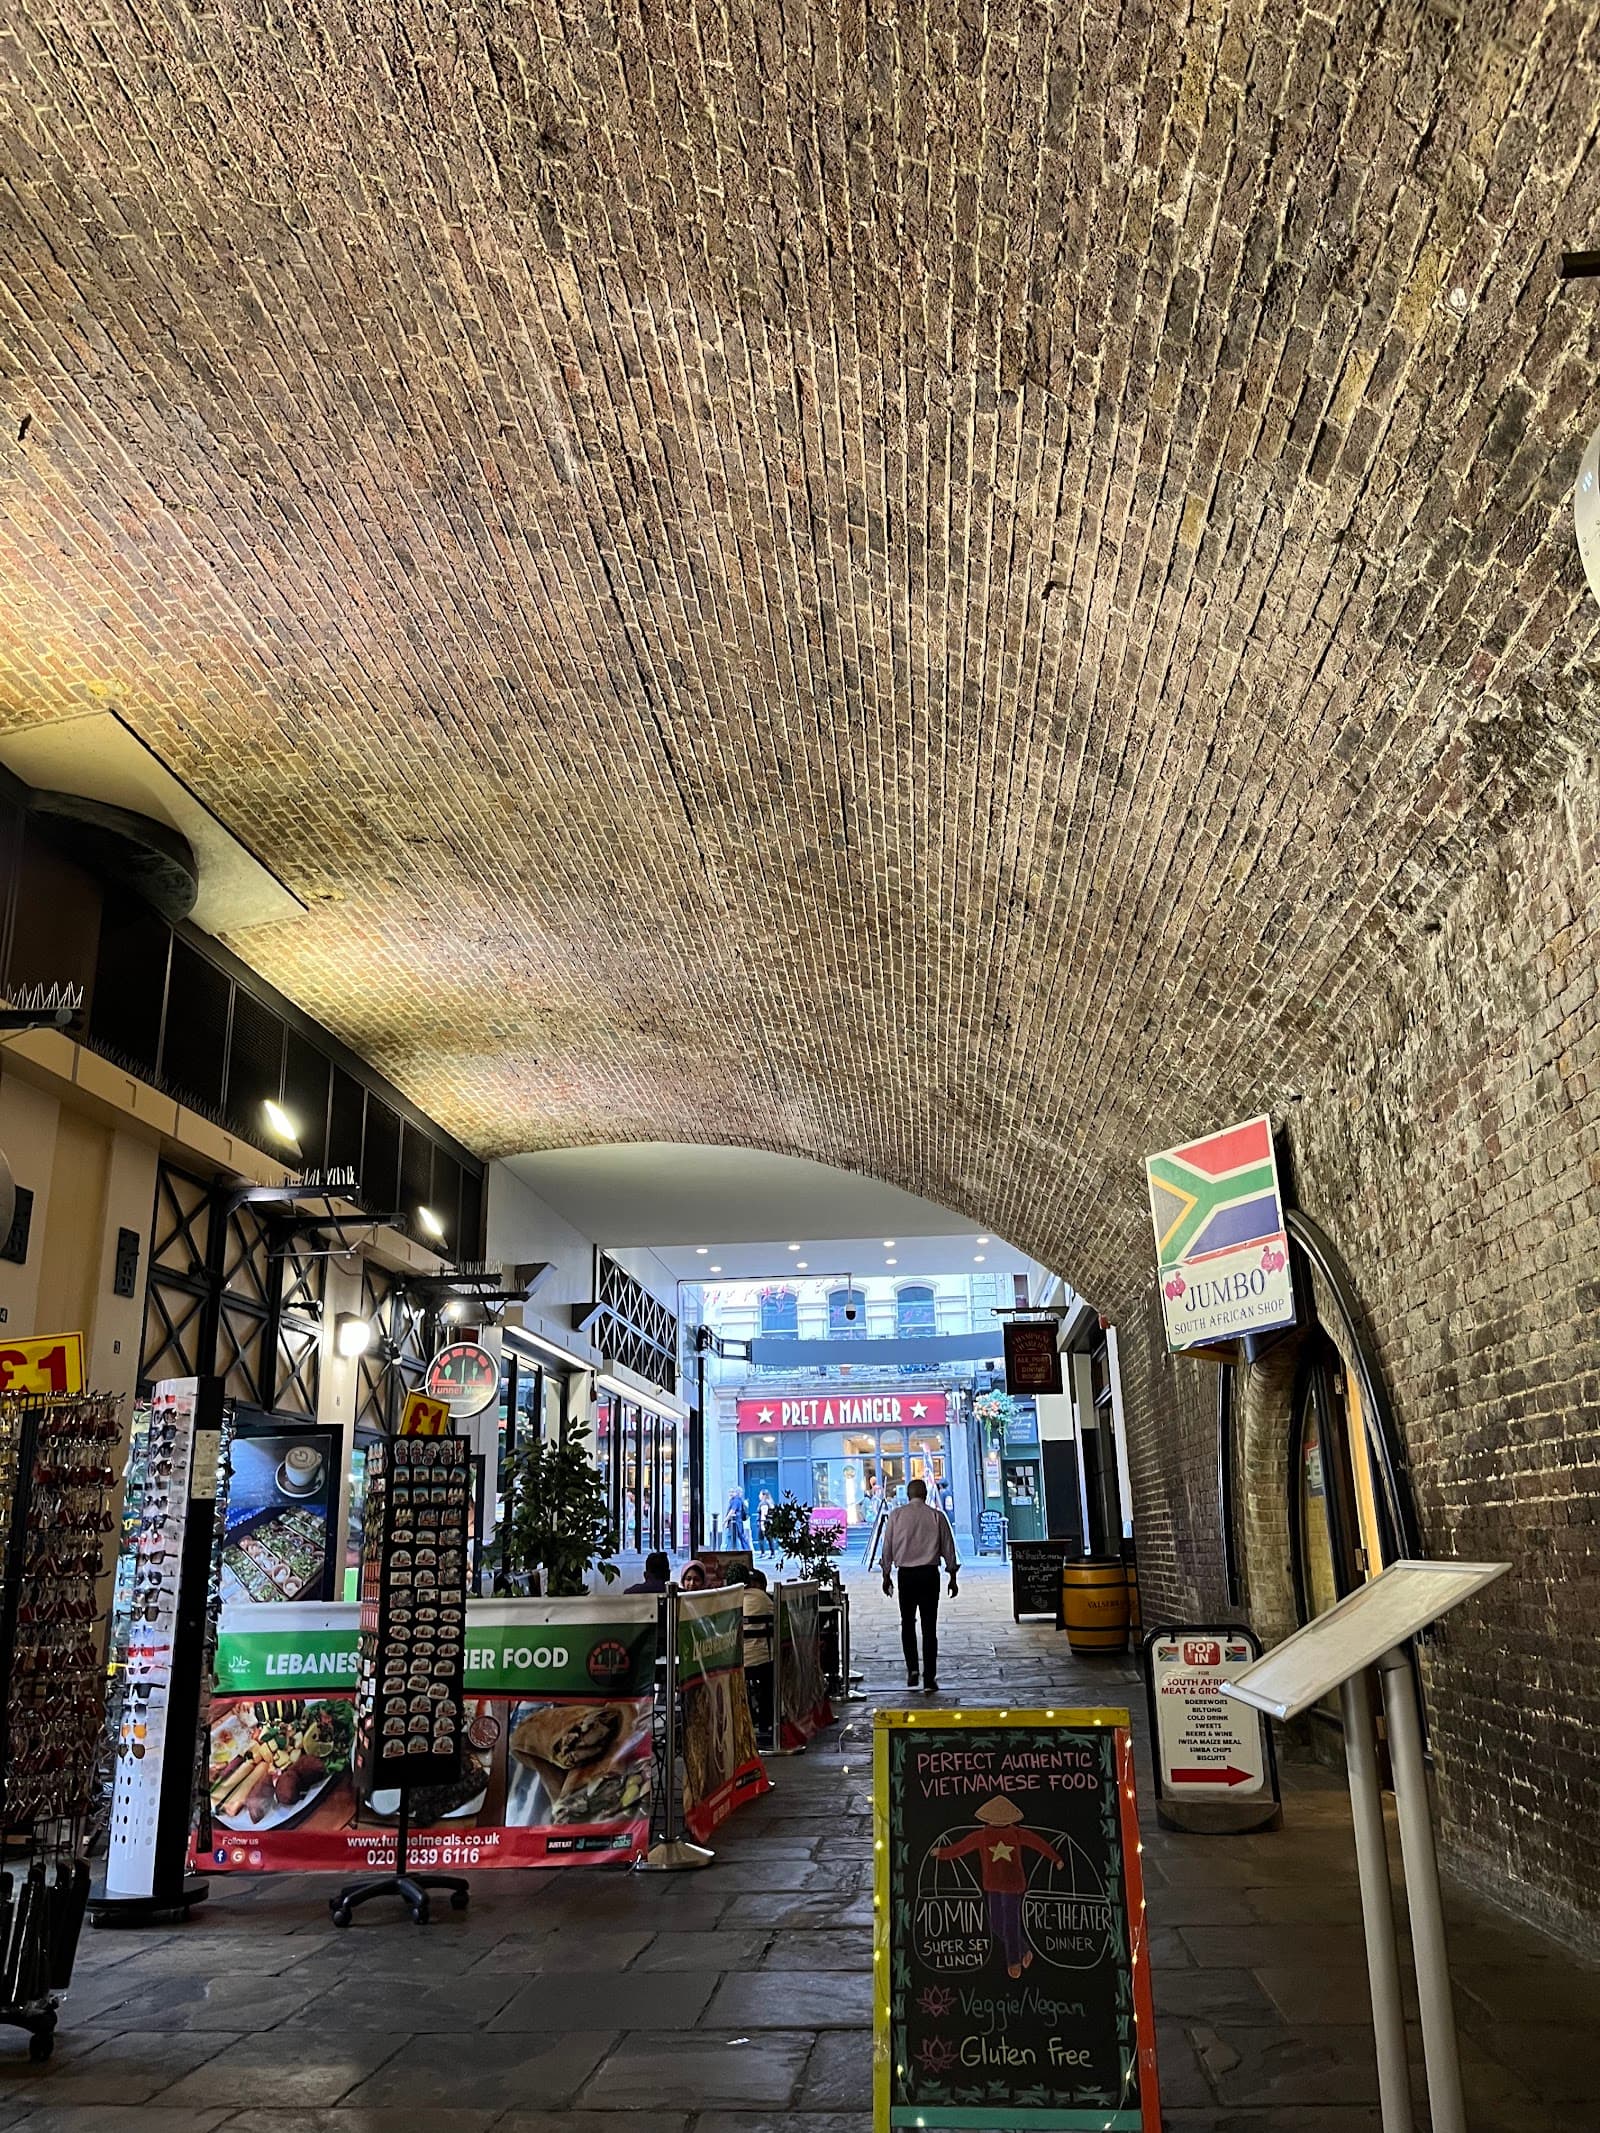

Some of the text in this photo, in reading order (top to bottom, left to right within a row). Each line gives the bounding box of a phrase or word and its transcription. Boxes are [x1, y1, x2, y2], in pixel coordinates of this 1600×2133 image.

[1185, 1268, 1265, 1312] JUMBO
[1174, 1298, 1285, 1335] SOUTH AFRICAN SHOP
[406, 1402, 443, 1435] £1
[781, 1397, 903, 1426] PRET A MANGER
[1187, 1642, 1215, 1654] POP
[1194, 1653, 1209, 1664] IN
[266, 1652, 361, 1676] LEBANES
[502, 1647, 569, 1669] FOOD
[1161, 1687, 1188, 1695] MEAT
[1198, 1687, 1219, 1695] GRO
[1168, 1678, 1199, 1686] SOUTH
[917, 1751, 1093, 1775] PERFECT AUTHENTIC
[920, 1772, 1099, 1799] VIETNAMESE FOOD
[222, 1836, 259, 1846] Follow us
[347, 1832, 500, 1847] www.tuelmeals.co.uk
[367, 1847, 480, 1865] 020 839 6116
[1025, 1900, 1112, 1931] PRE-THEATER
[921, 1938, 991, 1957] SUPER SET
[1045, 1935, 1096, 1952] DINNER
[935, 1953, 983, 1969] LUNCH
[958, 1985, 1087, 2035] Veggie/Vegan
[960, 2035, 1094, 2068] Gluten Free
